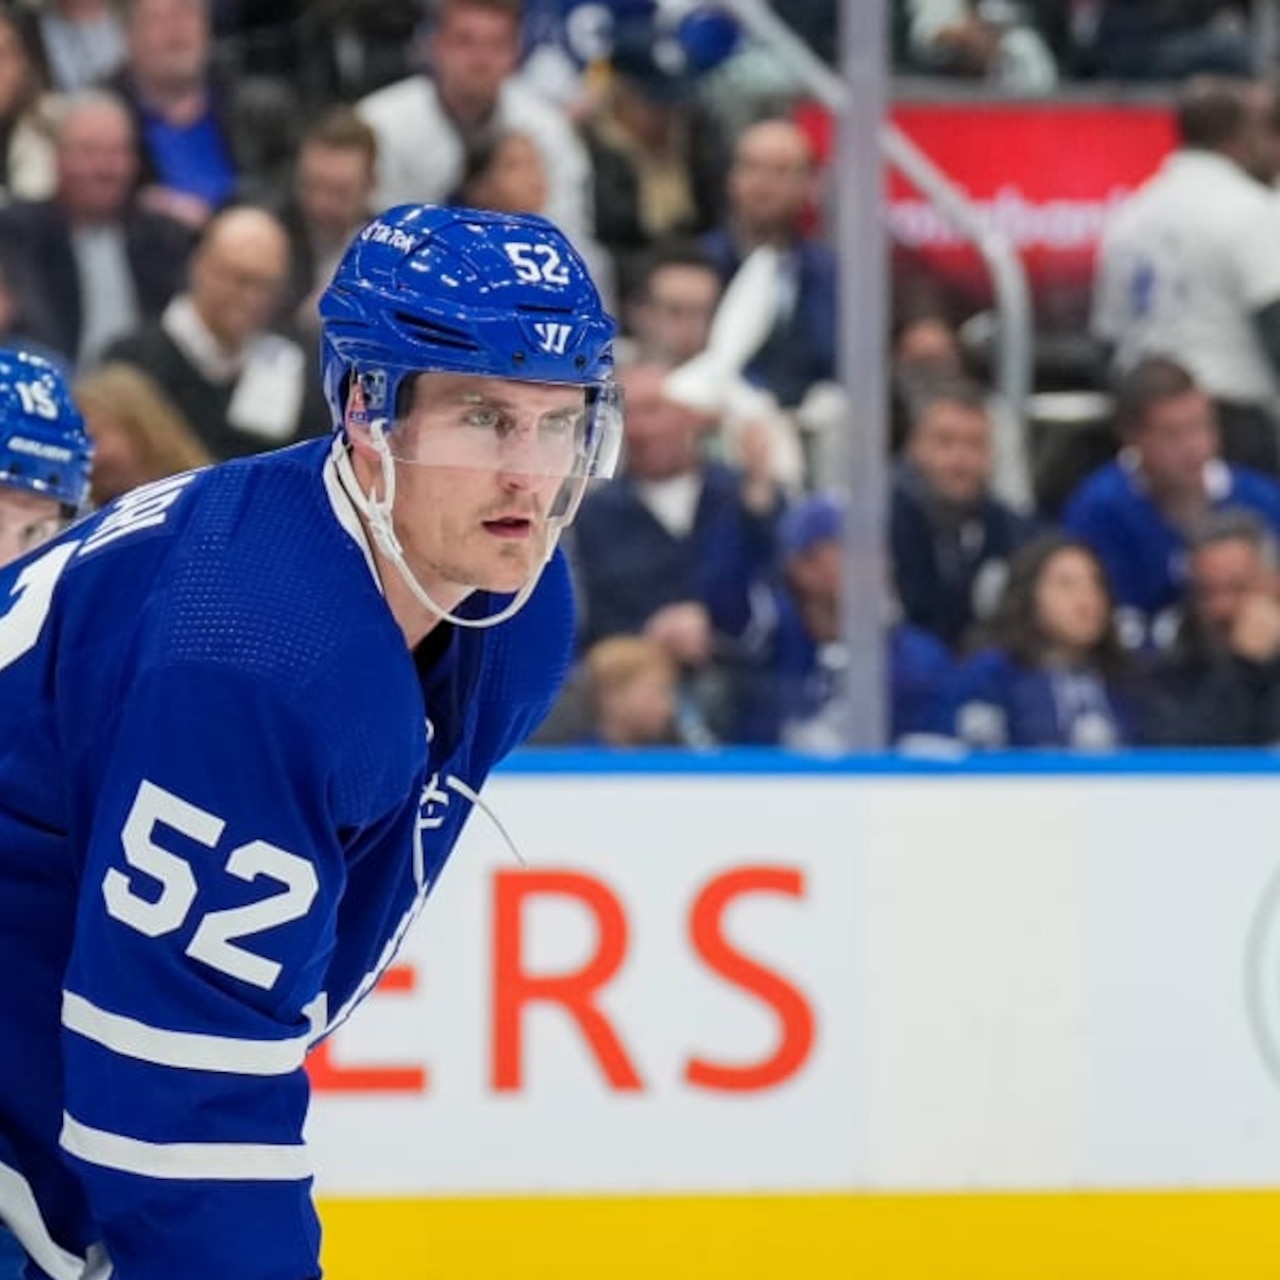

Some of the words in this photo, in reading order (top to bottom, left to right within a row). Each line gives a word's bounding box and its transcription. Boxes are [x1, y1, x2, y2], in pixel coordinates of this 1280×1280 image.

[505, 242, 570, 285] 52
[14, 381, 59, 421] 15
[102, 778, 319, 991] 52
